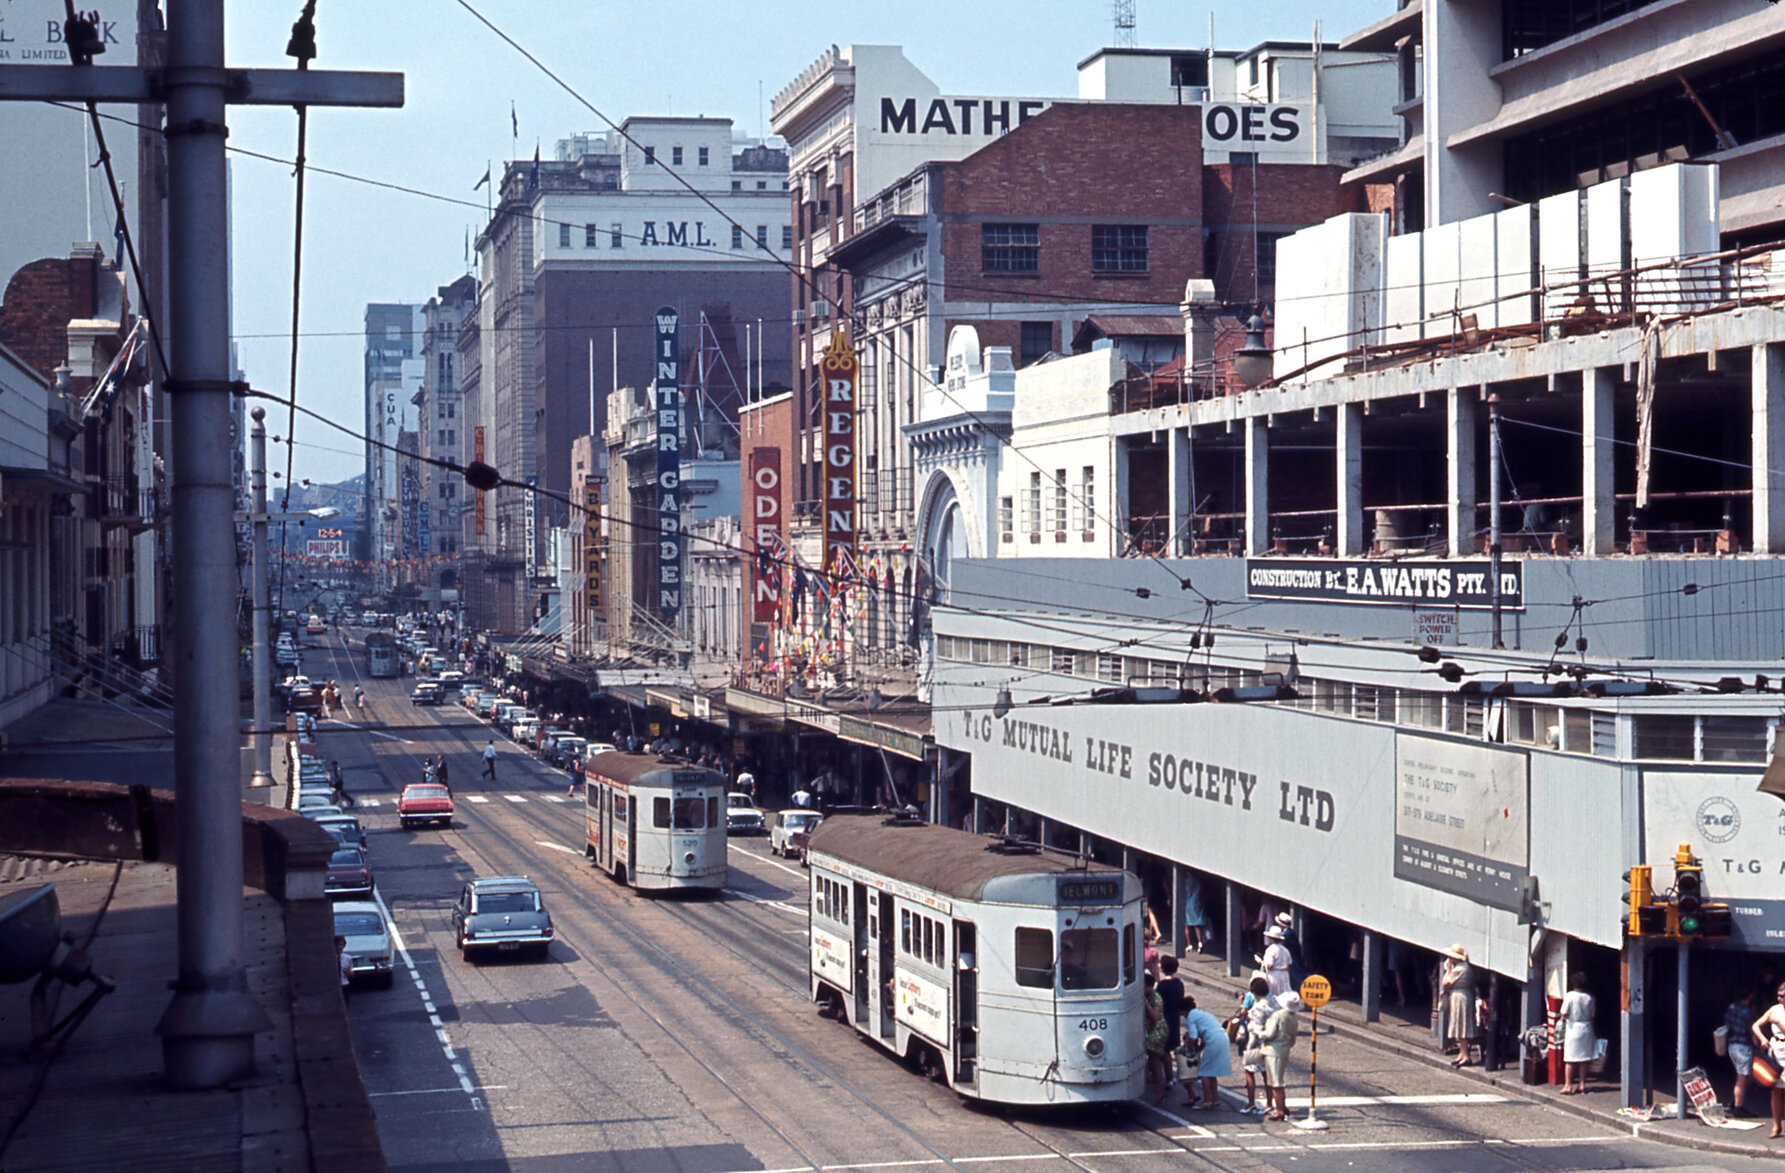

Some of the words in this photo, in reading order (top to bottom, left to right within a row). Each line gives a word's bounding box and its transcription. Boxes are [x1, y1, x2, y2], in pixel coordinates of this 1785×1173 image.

[47, 20, 119, 44] BK
[22, 49, 67, 60] LIMITED
[640, 221, 717, 247] A.M.L.
[656, 315, 679, 452] WINTER
[660, 471, 679, 608] GARDEN
[755, 467, 778, 602] ODEN
[308, 542, 340, 554] PHILIPS
[588, 492, 600, 607] BAYARDS
[1250, 568, 1321, 589] CONSTRUCTION
[1456, 573, 1487, 595] PTY.
[1500, 573, 1521, 595] TD.
[1418, 614, 1455, 625] SWITCH
[1418, 624, 1451, 634] POWER
[1426, 634, 1444, 645] OFF
[1002, 718, 1073, 763] MUTUAL
[1086, 737, 1132, 780] LIFE
[1149, 752, 1258, 811] SOCIETY
[1279, 781, 1335, 833] LTD
[1703, 814, 1734, 827] T&G
[1303, 981, 1329, 990] SAFETY
[1305, 991, 1325, 999] ZONE
[1078, 1019, 1108, 1031] 408
